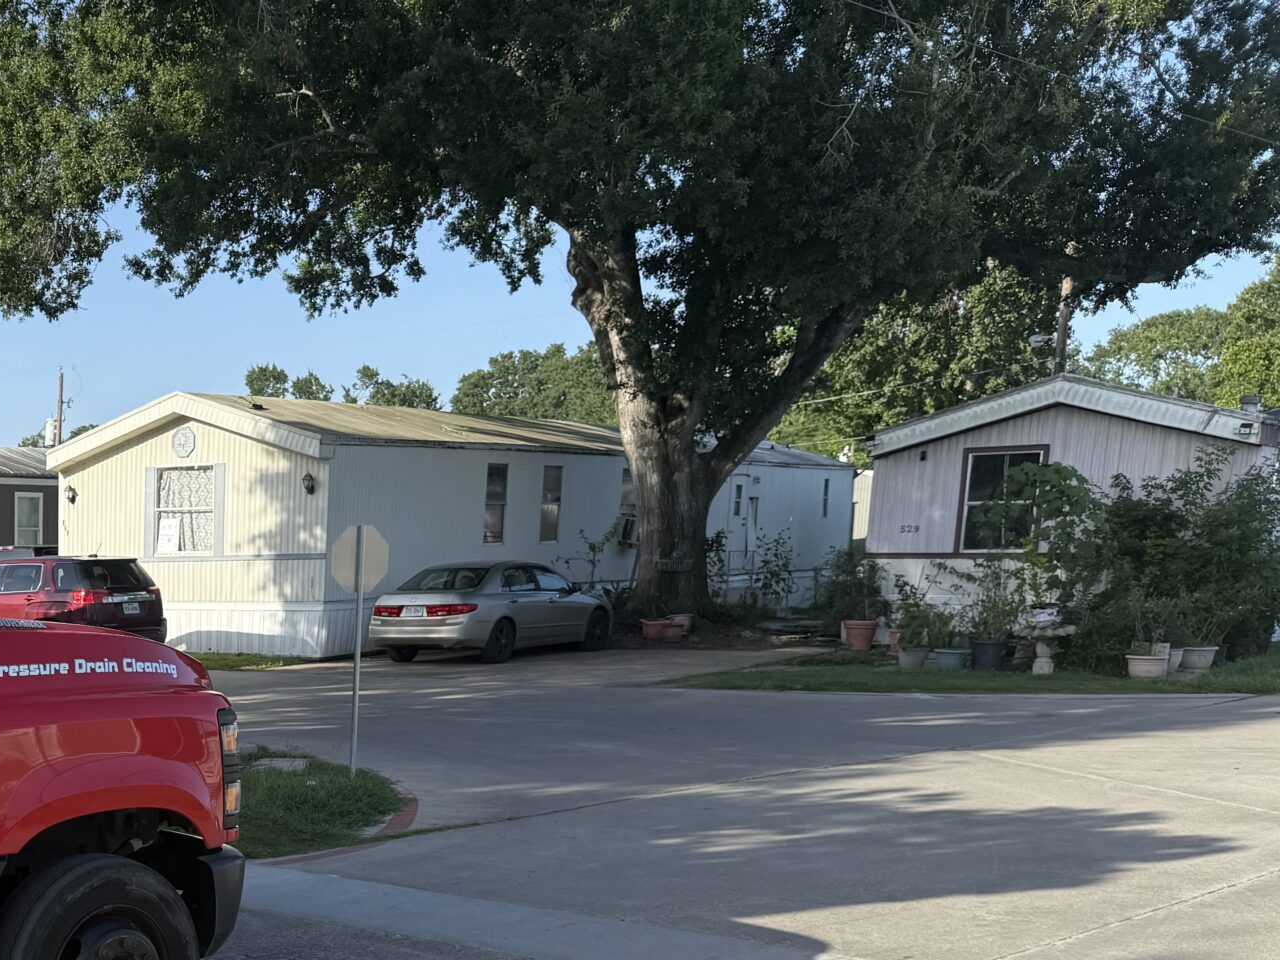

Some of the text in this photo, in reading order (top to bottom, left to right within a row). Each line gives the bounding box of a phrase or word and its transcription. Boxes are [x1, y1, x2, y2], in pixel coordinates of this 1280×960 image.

[900, 524, 920, 534] 529
[74, 658, 119, 674] Drain
[122, 658, 178, 678] Cleaning
